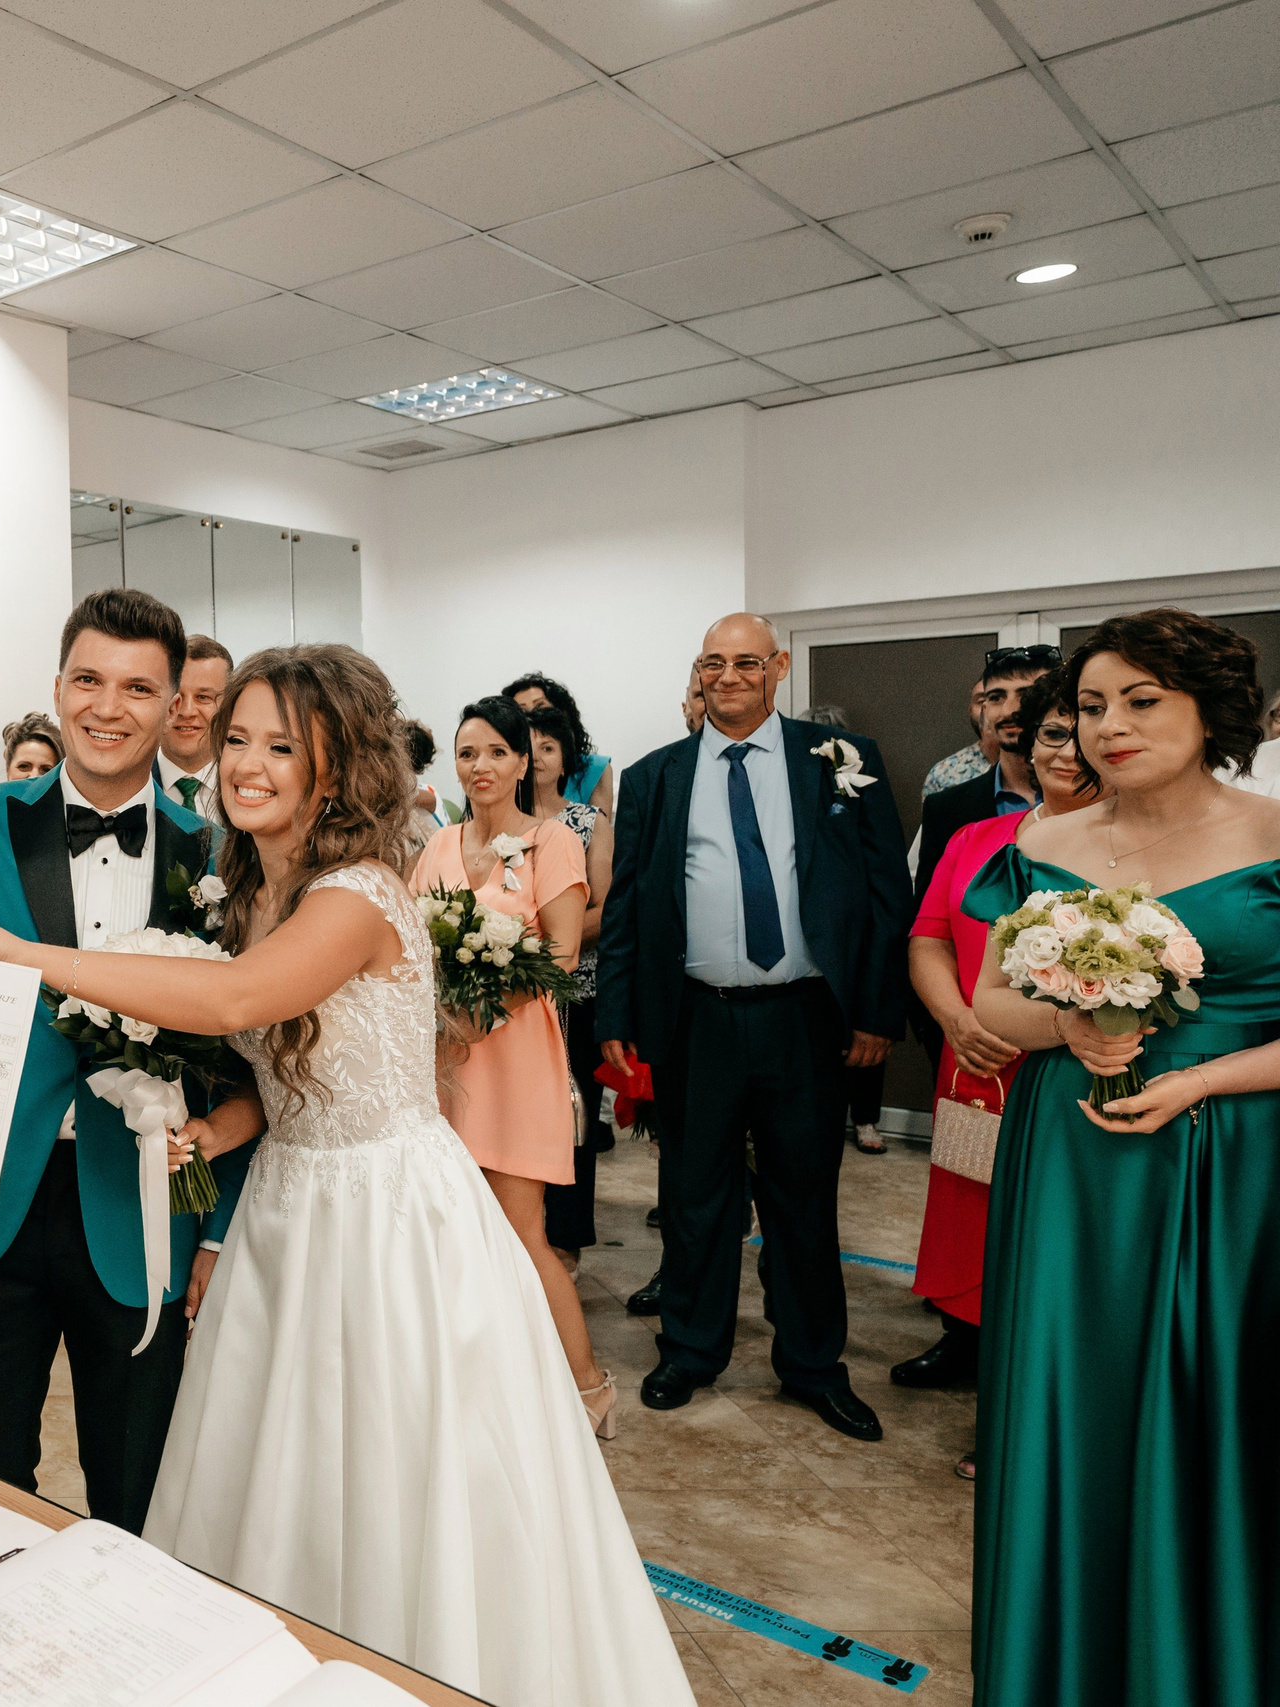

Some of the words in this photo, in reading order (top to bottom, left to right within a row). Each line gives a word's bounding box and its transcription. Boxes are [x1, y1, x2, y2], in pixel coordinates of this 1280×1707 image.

[687, 1581, 704, 1589] de
[670, 1591, 734, 1620] Măsură
[735, 1599, 774, 1616] metri
[762, 1617, 811, 1639] Pentru
